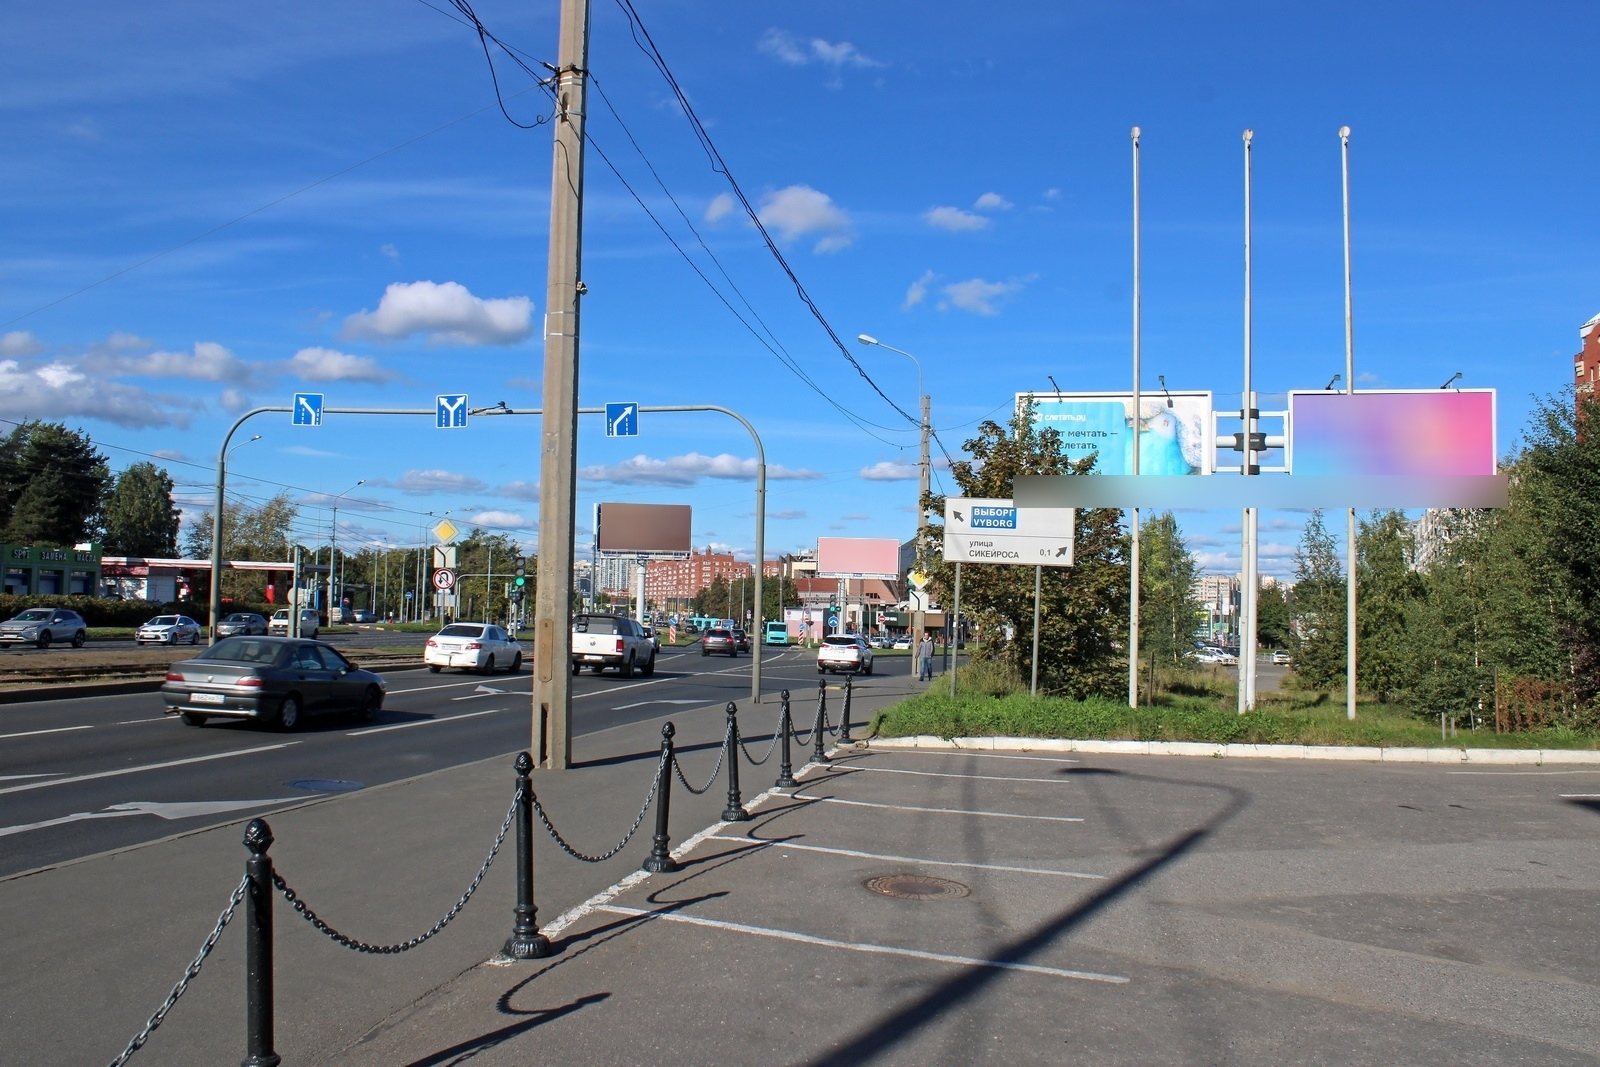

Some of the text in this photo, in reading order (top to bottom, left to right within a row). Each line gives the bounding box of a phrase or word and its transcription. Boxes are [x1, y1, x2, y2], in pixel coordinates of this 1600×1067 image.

[1045, 414, 1086, 422] слетать.ру
[974, 508, 1014, 517] ВЫБОРГ
[973, 519, 1013, 527] VYBORG
[969, 540, 993, 548] улица
[41, 551, 67, 561] ЗАМЕНА
[76, 553, 96, 562] МАСЛА
[969, 549, 1019, 559] СИКЕЙРОСА
[1039, 549, 1051, 557] 0,1
